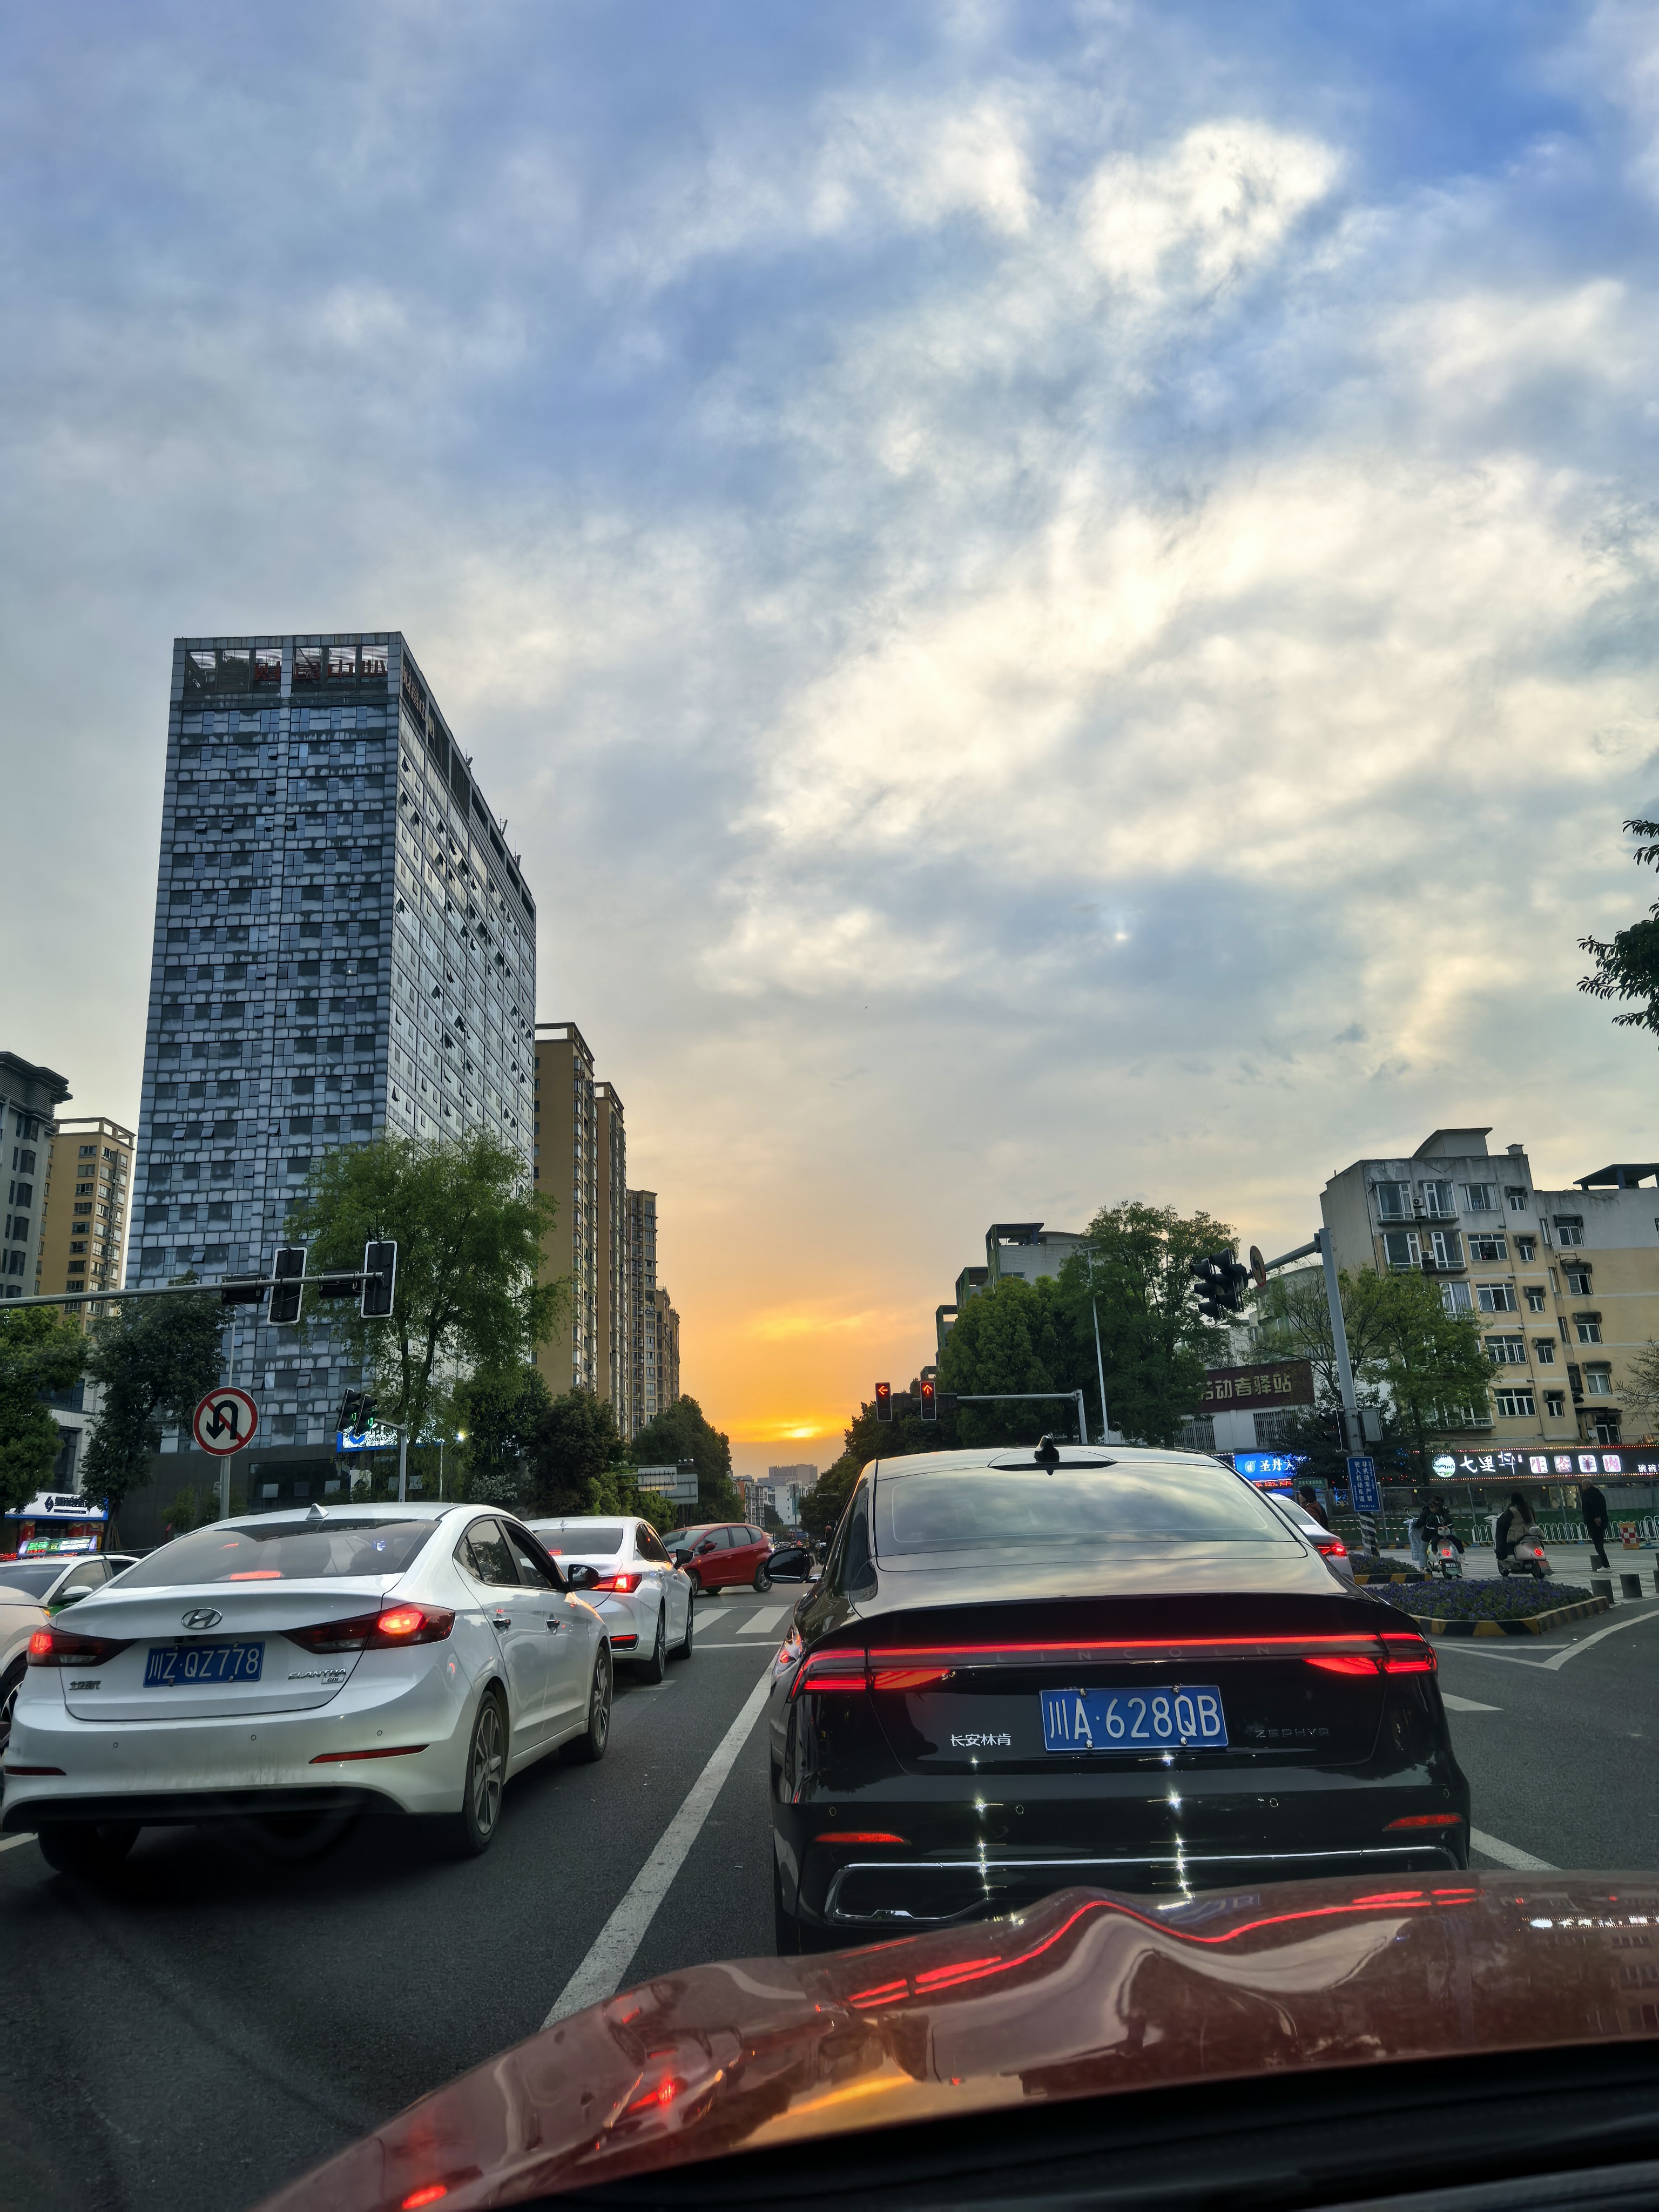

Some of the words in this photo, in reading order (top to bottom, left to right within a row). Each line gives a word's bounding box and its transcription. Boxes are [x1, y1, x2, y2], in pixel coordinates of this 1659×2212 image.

[1637, 1464, 1659, 1473] 碗碗
[1049, 1695, 1221, 1741] 川A·628QB
[950, 1733, 1011, 1747] 长安林肯
